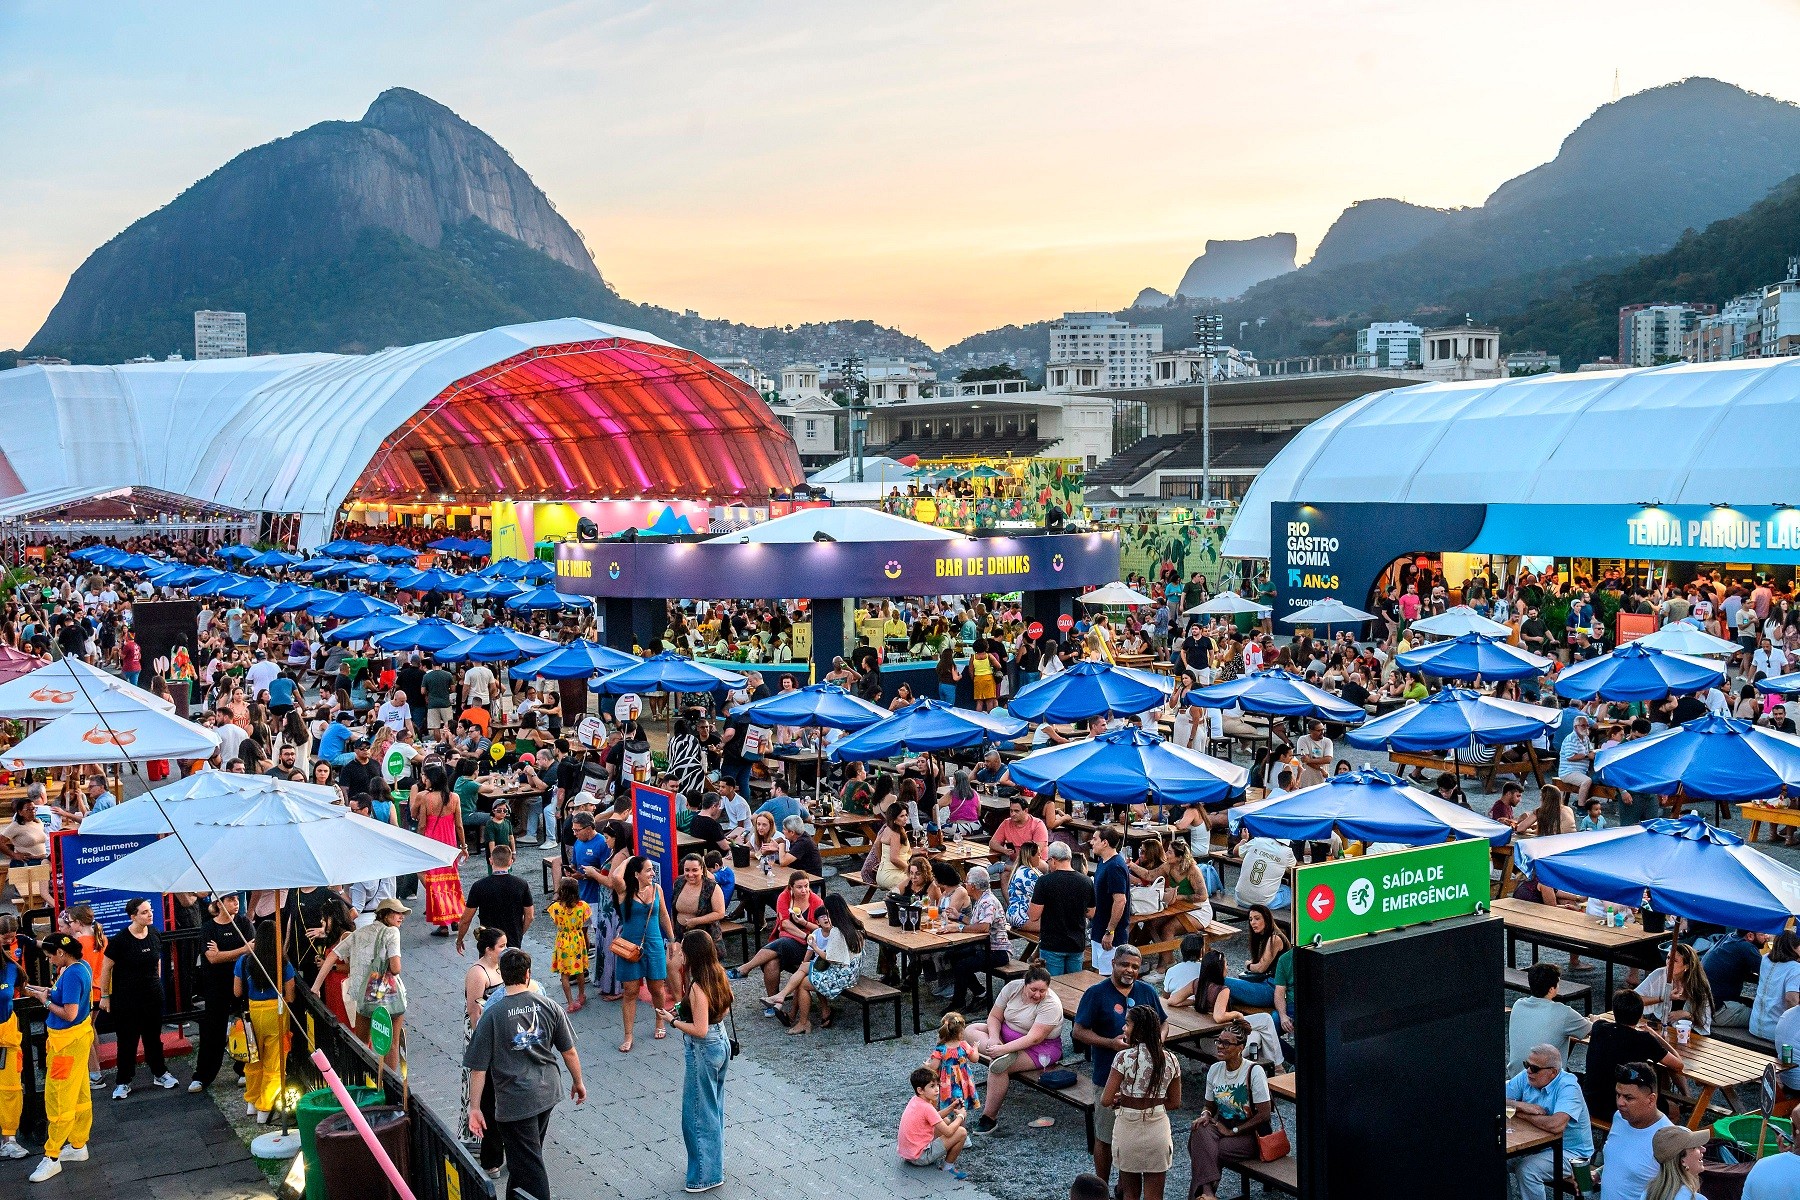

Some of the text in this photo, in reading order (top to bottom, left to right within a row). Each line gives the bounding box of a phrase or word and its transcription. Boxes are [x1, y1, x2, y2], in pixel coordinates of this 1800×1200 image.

[1287, 521, 1310, 536] RIO
[1627, 518, 1682, 546] TENDA
[1688, 520, 1760, 550] PARQUE
[1287, 536, 1339, 552] GASTRO
[935, 555, 1030, 577] BAR DE DRINKS
[1287, 551, 1330, 566] NOMIA
[1287, 568, 1302, 587] 15
[1288, 598, 1295, 606] O
[82, 841, 139, 854] Regulamento
[76, 855, 110, 864] Tirolesa
[1250, 860, 1267, 885] 8
[1382, 865, 1443, 890] SAÍDA DE
[1382, 884, 1469, 912] EMERGÊNCIA
